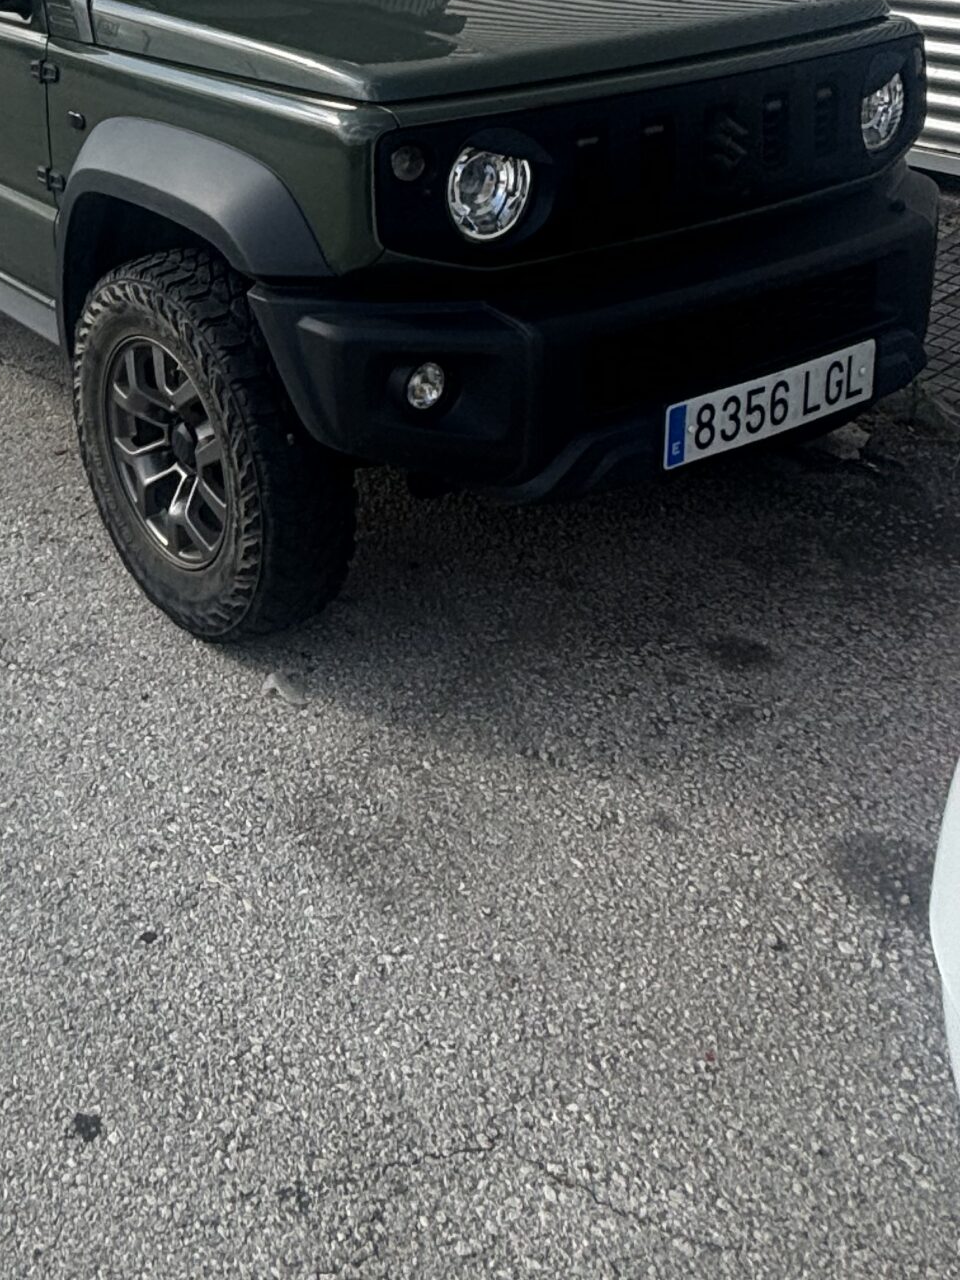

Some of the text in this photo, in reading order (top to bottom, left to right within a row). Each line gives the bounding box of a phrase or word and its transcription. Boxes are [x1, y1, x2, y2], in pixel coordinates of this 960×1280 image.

[671, 355, 863, 456] E 8356 LGL
